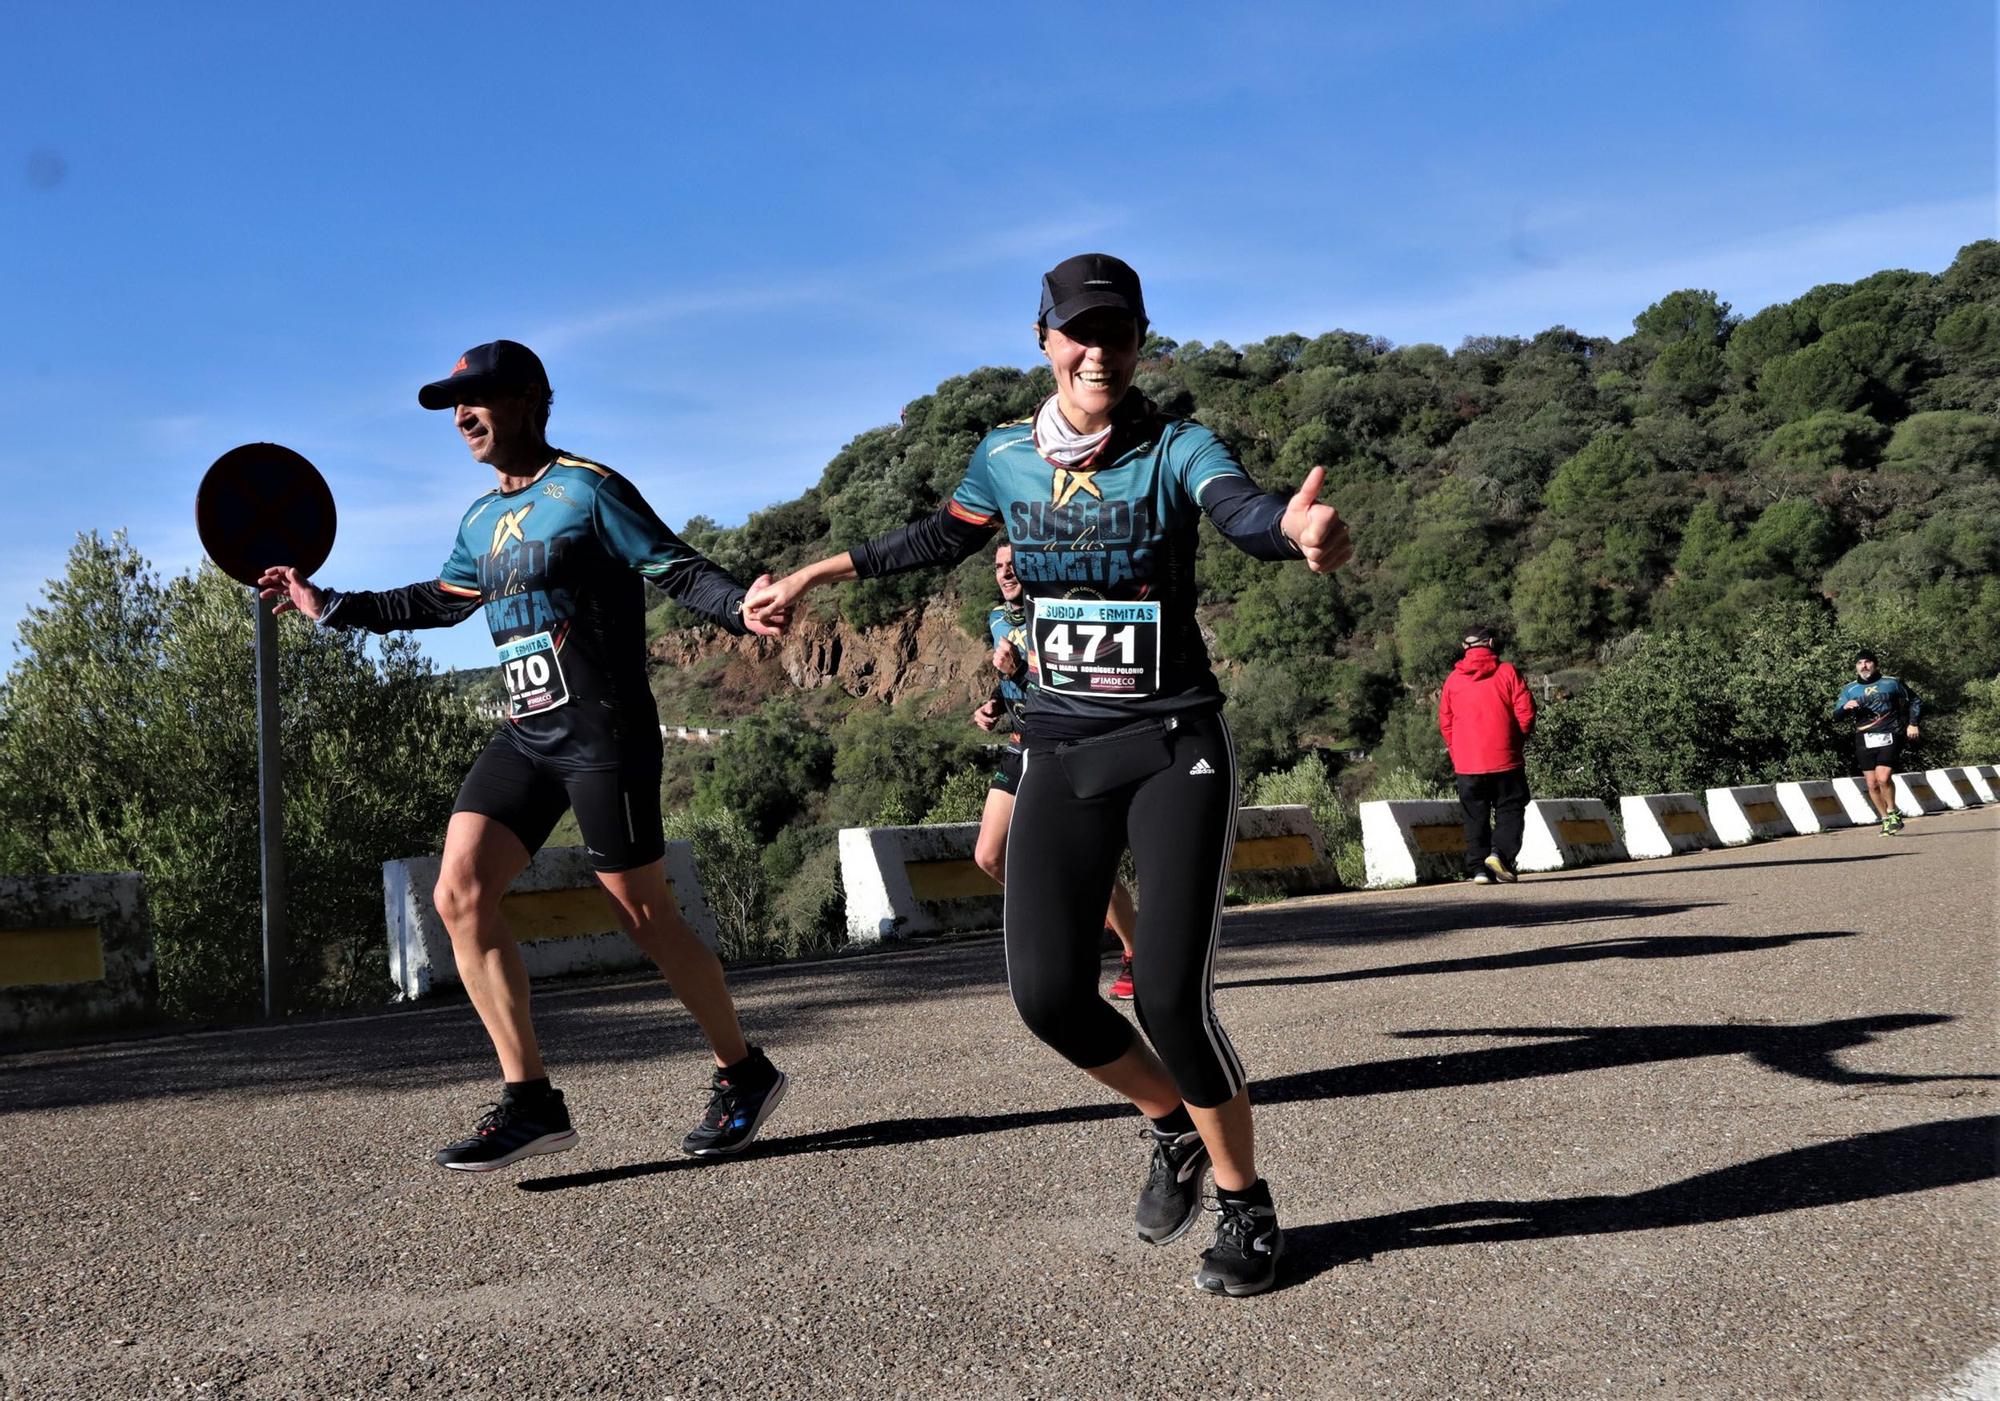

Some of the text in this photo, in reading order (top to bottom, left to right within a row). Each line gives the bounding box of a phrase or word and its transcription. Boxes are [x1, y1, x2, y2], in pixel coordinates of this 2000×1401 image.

[543, 482, 565, 499] SIG
[1050, 467, 1105, 512] IX
[490, 501, 535, 562] IX
[1009, 496, 1155, 542] SUBIDA
[1043, 525, 1105, 551] a las
[504, 568, 526, 596] las
[1014, 548, 1153, 588] ERMITAS
[1046, 606, 1154, 621] SUBIDA ERMITAS
[514, 638, 549, 656] ERMITAS
[1044, 624, 1135, 664] 471
[1100, 677, 1135, 686] IMDECO
